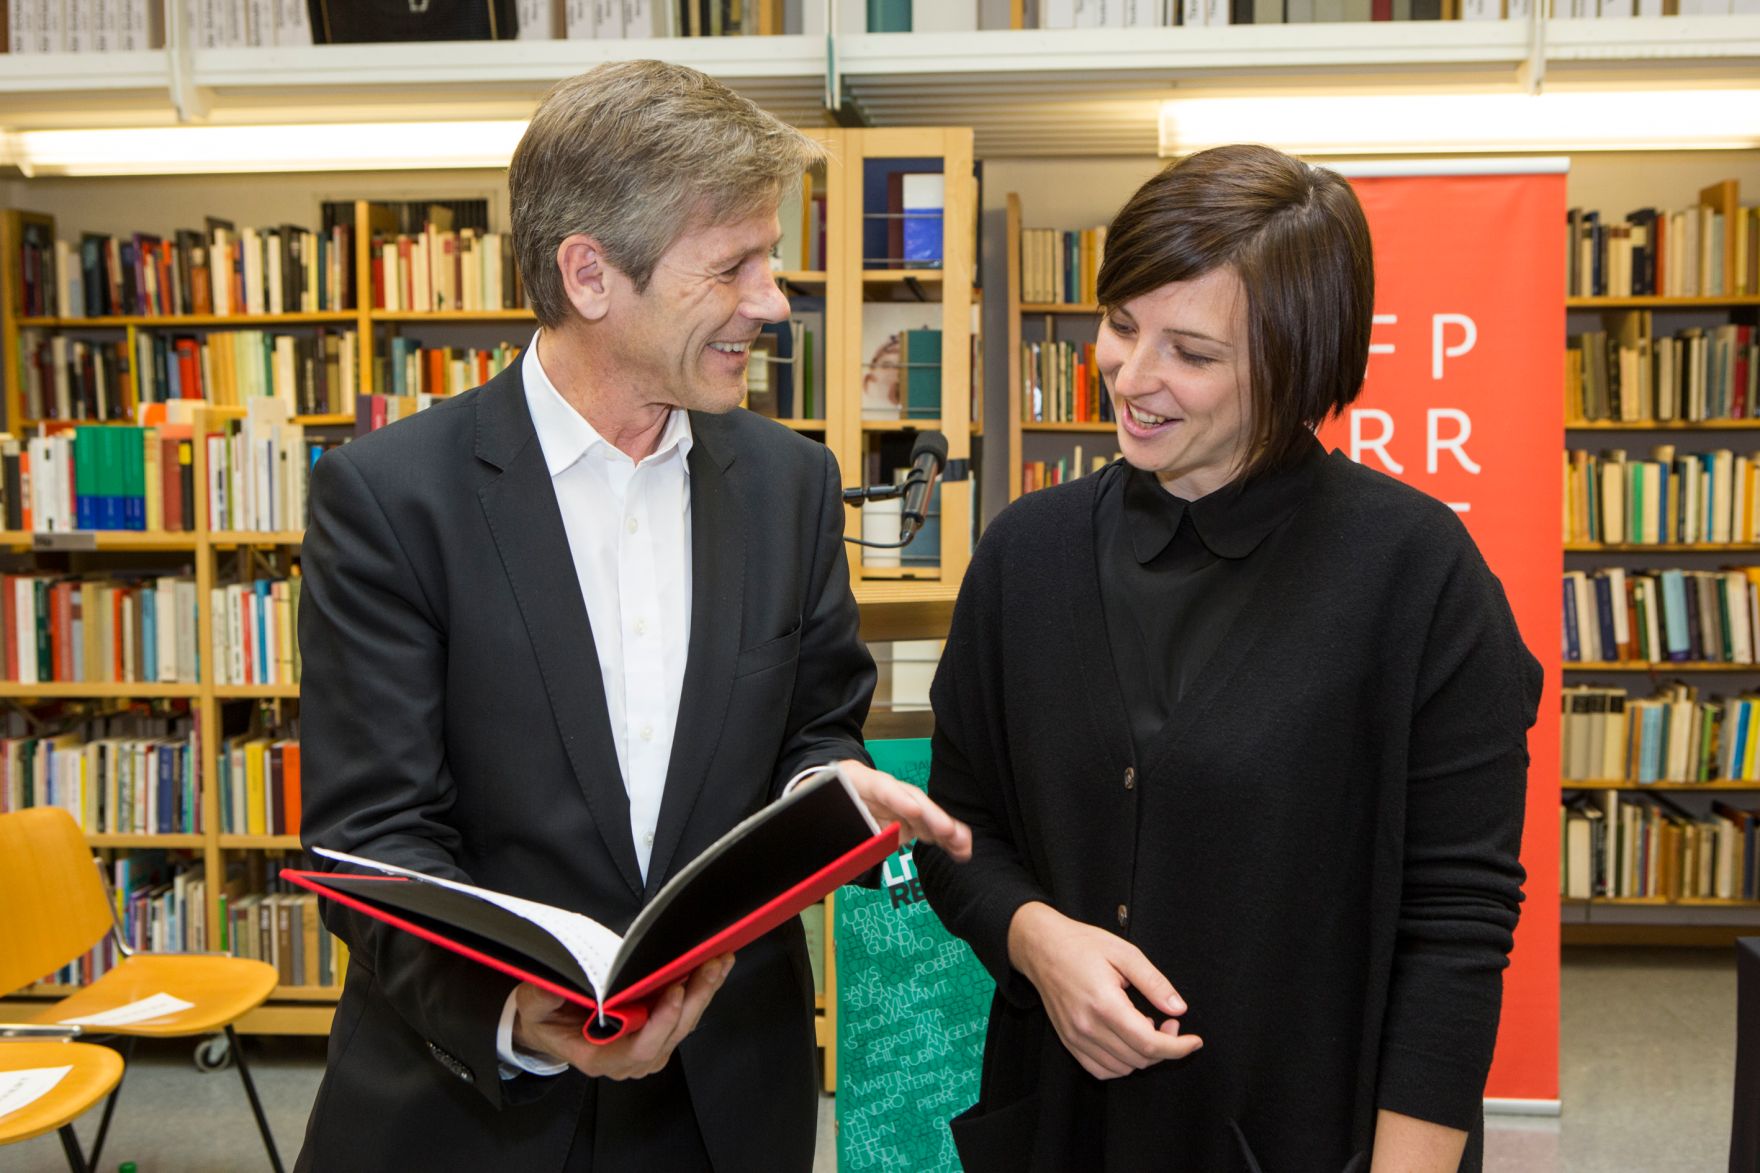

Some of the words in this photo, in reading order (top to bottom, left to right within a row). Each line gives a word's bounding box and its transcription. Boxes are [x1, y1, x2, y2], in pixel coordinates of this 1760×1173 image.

[862, 920, 909, 943] PAULA
[867, 931, 916, 954] GUNDI
[914, 950, 966, 976] ROBERT
[853, 978, 921, 1010] SUSANNE
[846, 1006, 915, 1035] THOMAS
[868, 1021, 943, 1053] SEBASTIAN
[900, 1042, 953, 1068] RUBINA
[852, 1068, 911, 1095] MARTIN
[886, 1066, 955, 1097] CATERINA
[941, 1069, 979, 1091] HOPE
[844, 1097, 904, 1123] SANDRO
[916, 1089, 958, 1111] PIERRE
